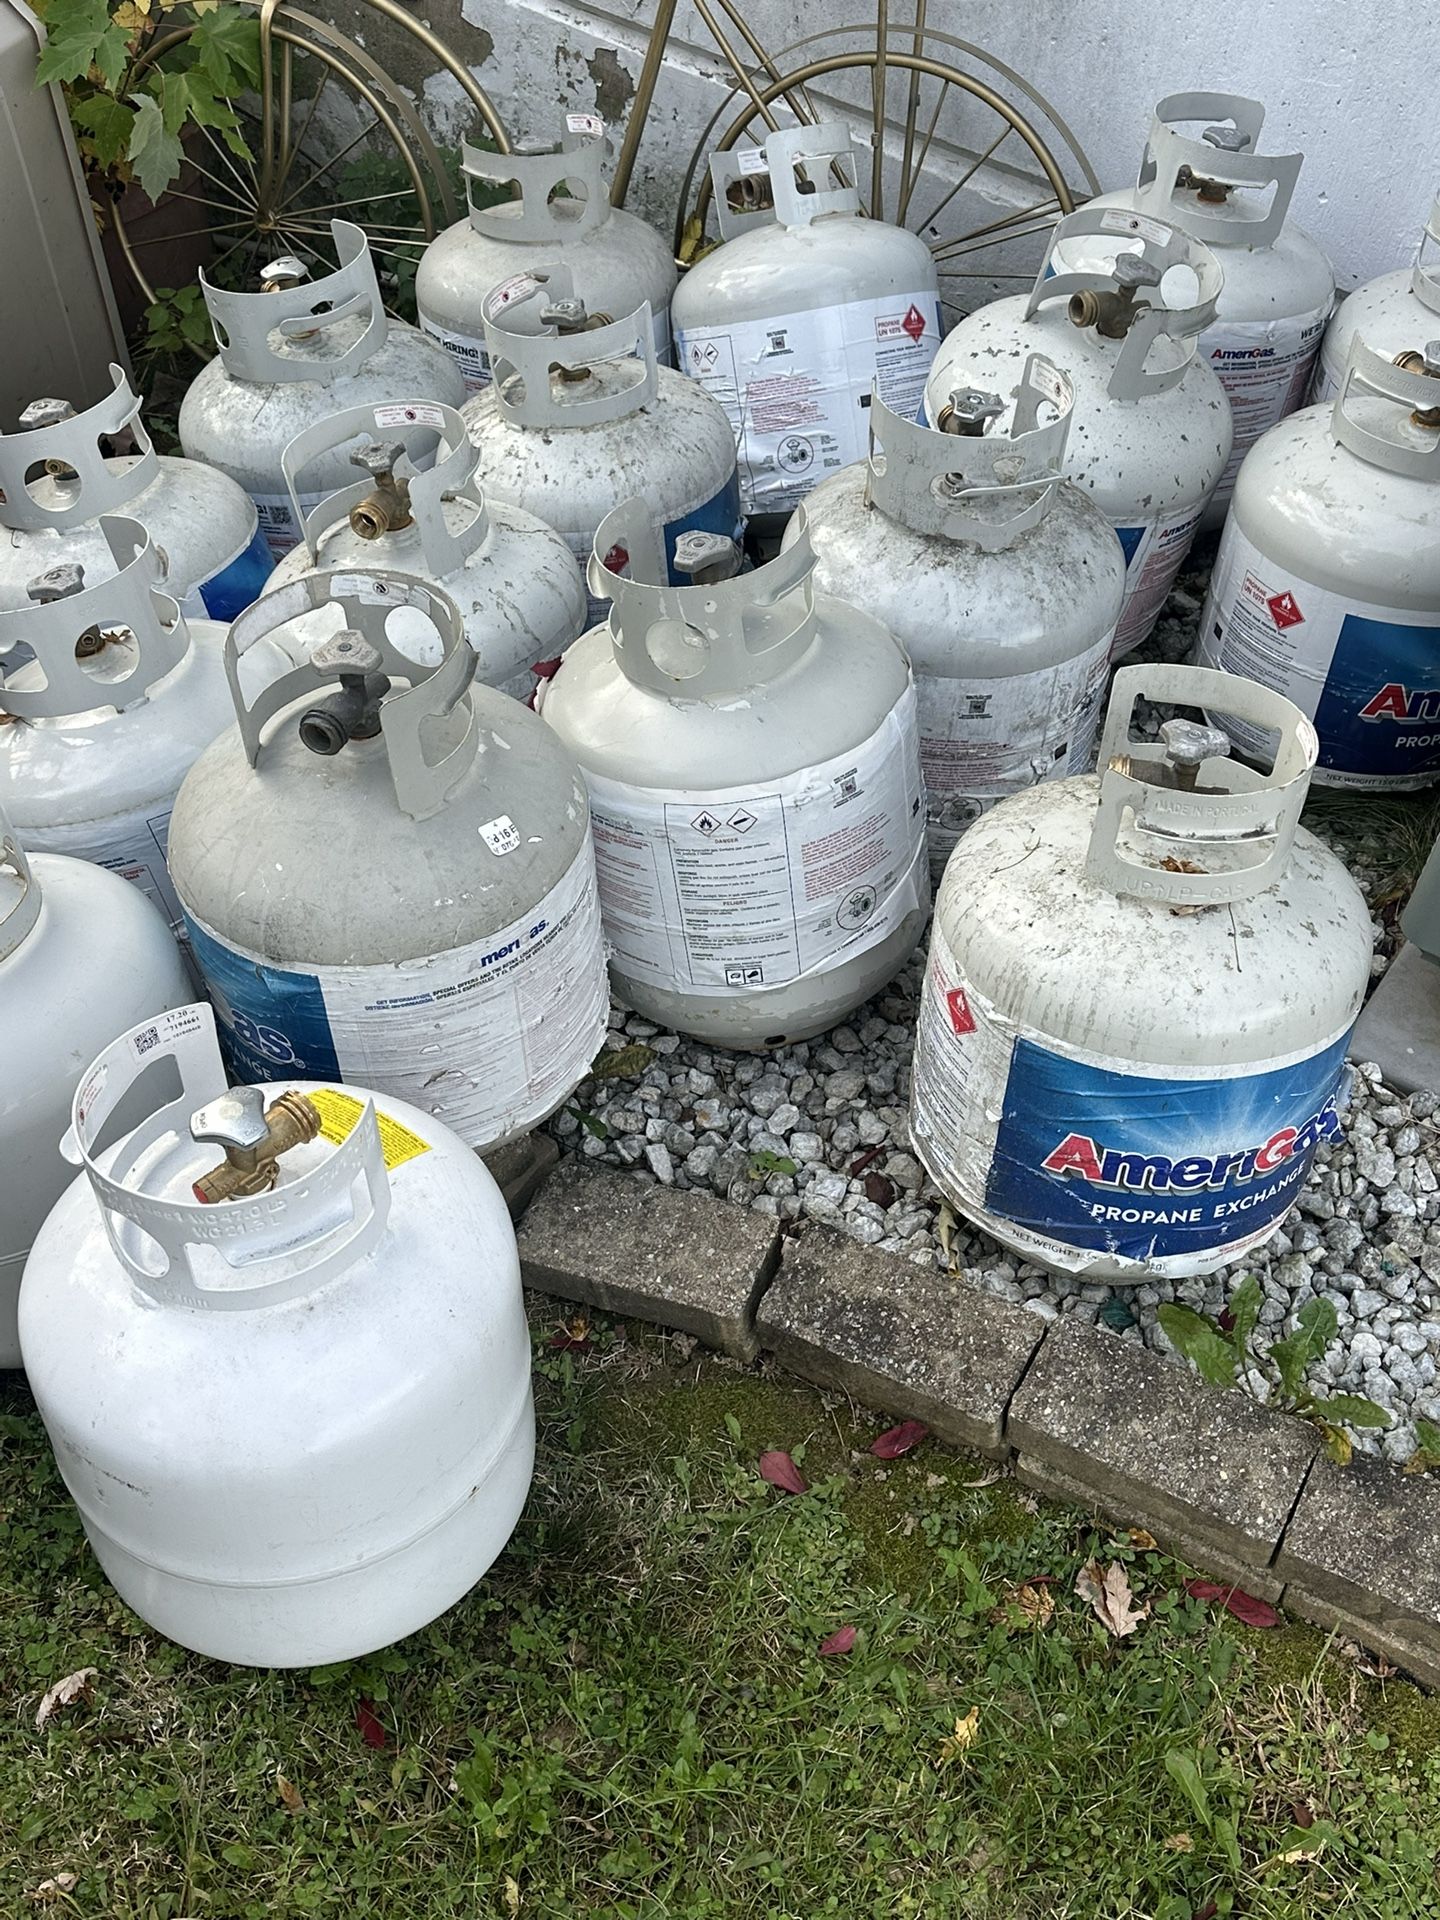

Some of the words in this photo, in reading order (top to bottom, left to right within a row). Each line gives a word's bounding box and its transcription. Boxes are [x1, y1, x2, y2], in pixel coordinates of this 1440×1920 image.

[1211, 347, 1274, 360] AmeriGas
[1395, 735, 1440, 748] PROP
[1157, 801, 1188, 815] MADE
[1190, 804, 1203, 816] IN
[1206, 803, 1259, 818] PORTUGAL
[1041, 1093, 1346, 1193] AmeriGas
[1091, 1202, 1203, 1225] PROPANE
[1213, 1159, 1306, 1219] EXCHANGE
[1011, 1228, 1031, 1243] NET
[1032, 1236, 1074, 1257] WEIGHT
